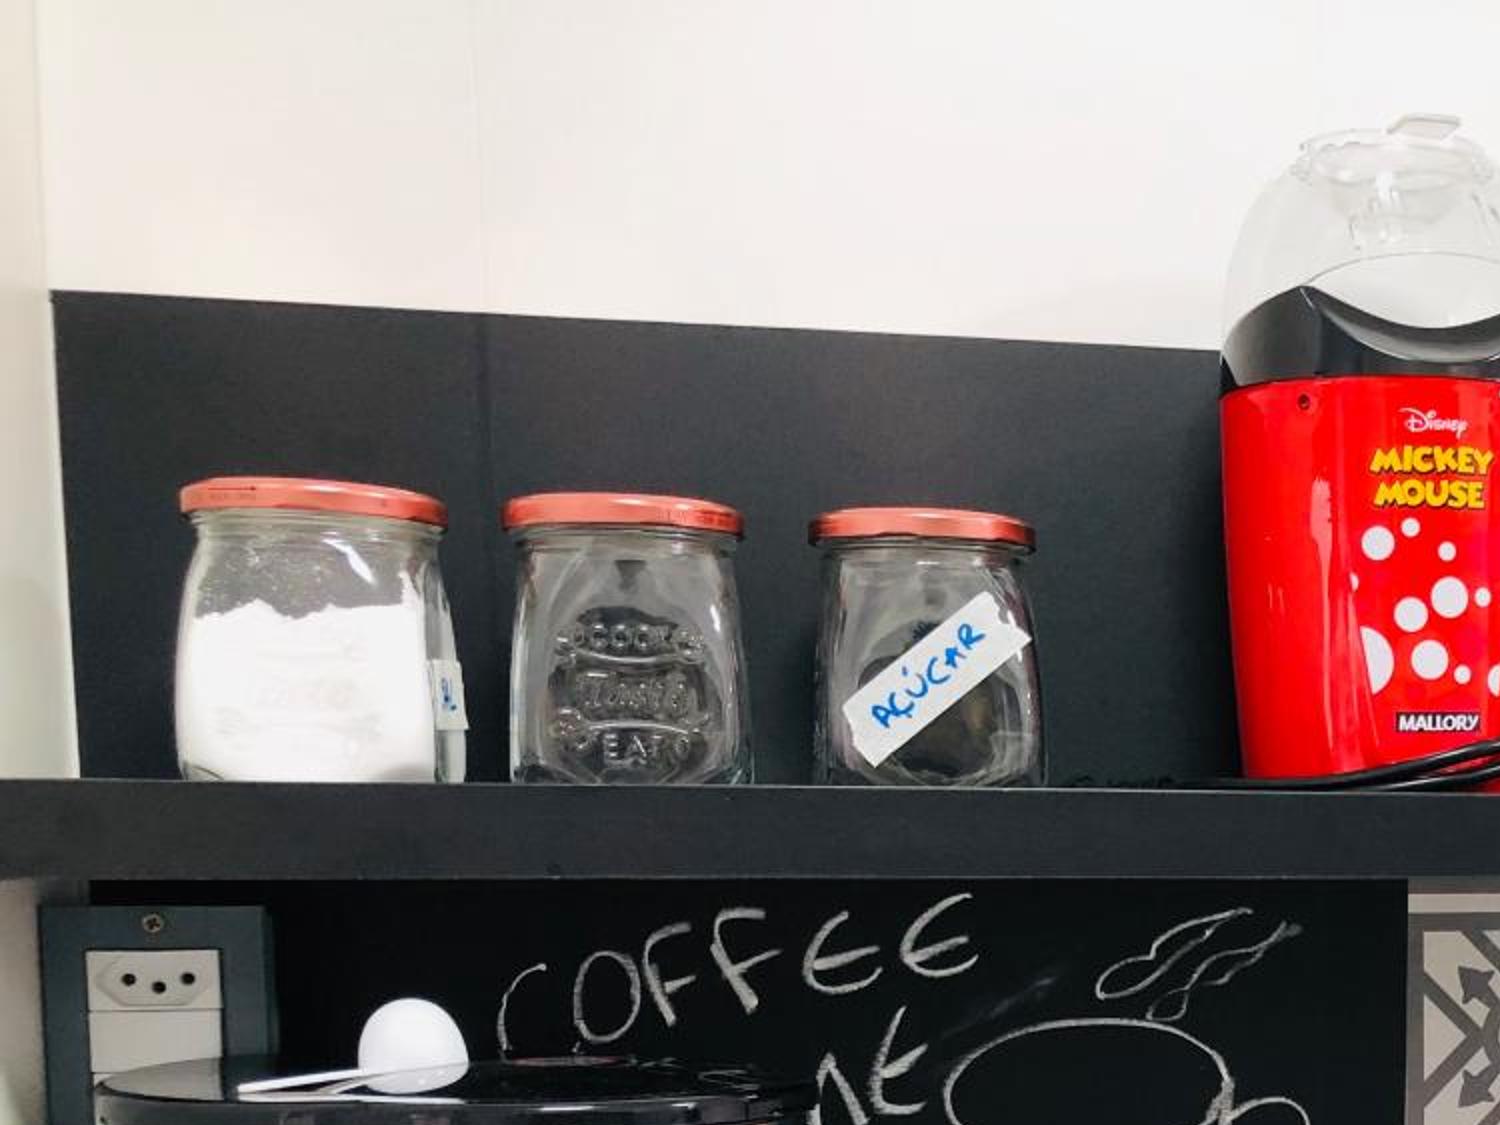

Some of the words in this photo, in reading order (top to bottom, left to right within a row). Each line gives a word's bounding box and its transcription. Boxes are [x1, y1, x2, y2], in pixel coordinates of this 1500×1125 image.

[1398, 406, 1467, 440] Disney
[1369, 444, 1494, 476] MICKEY
[1373, 479, 1486, 510] MOUSE
[1398, 712, 1479, 732] MALLORY
[497, 892, 979, 1052] COFFEE
